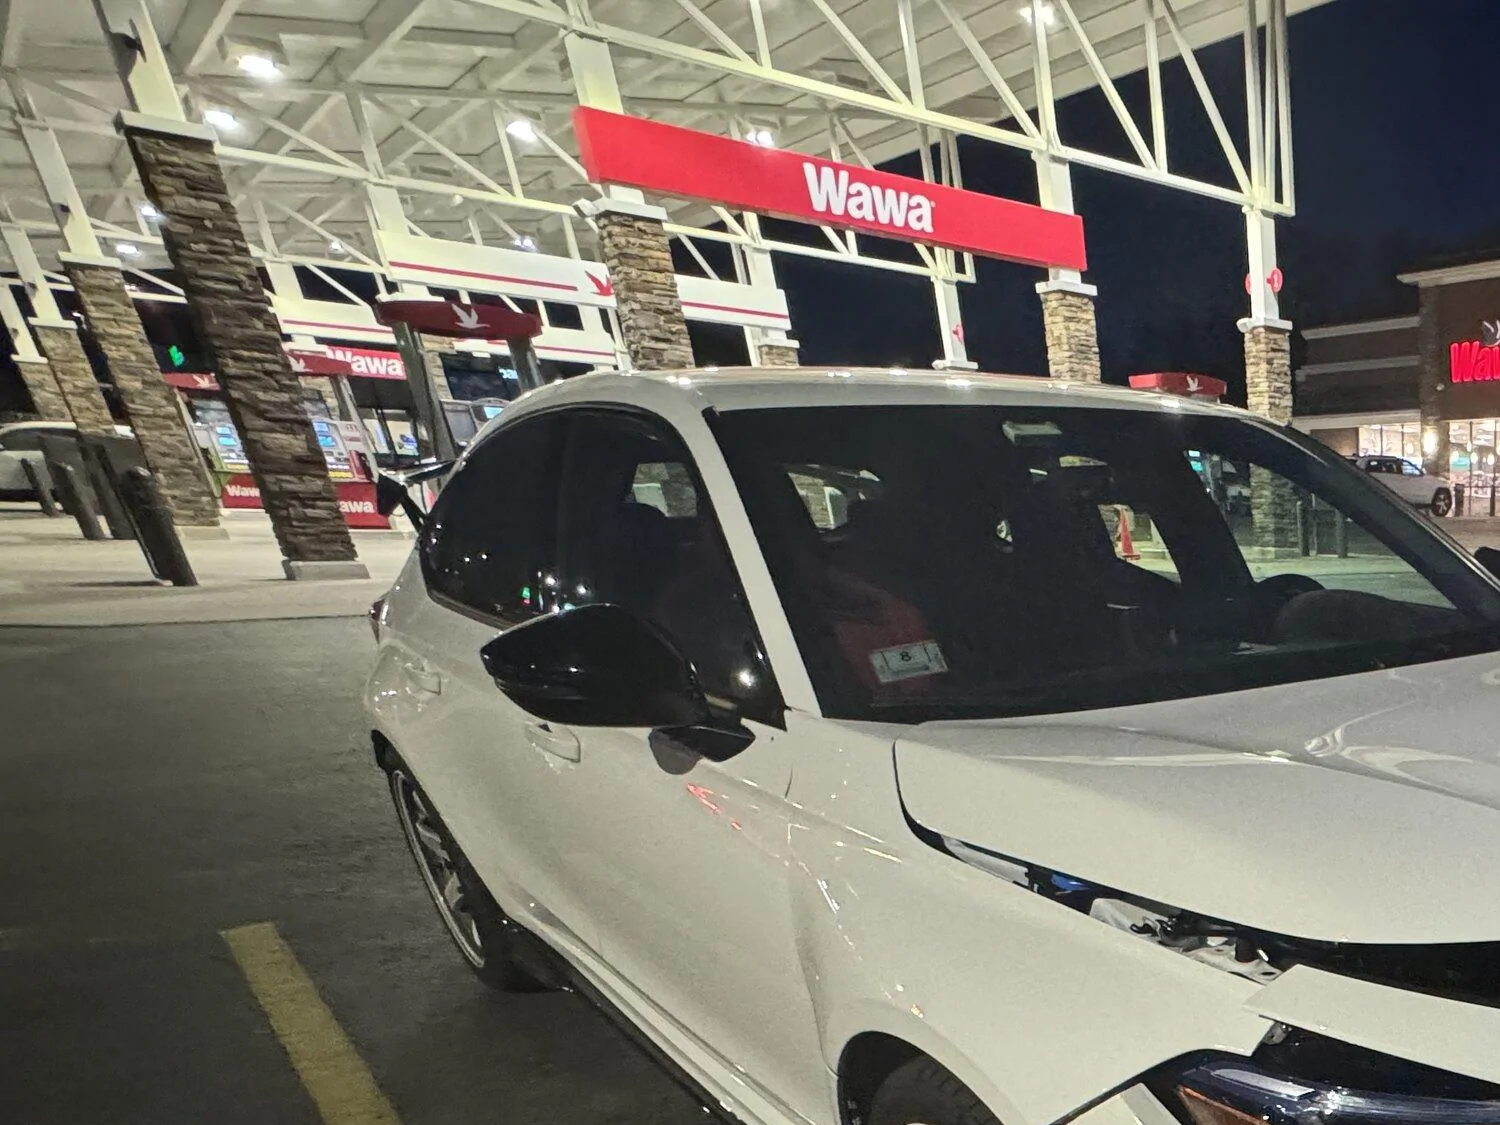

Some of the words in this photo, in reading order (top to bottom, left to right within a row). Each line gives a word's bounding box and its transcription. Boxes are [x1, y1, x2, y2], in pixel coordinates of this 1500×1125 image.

[803, 162, 934, 233] Wawa
[224, 484, 260, 497] Waw
[339, 501, 375, 513] awa
[900, 651, 912, 662] 8
